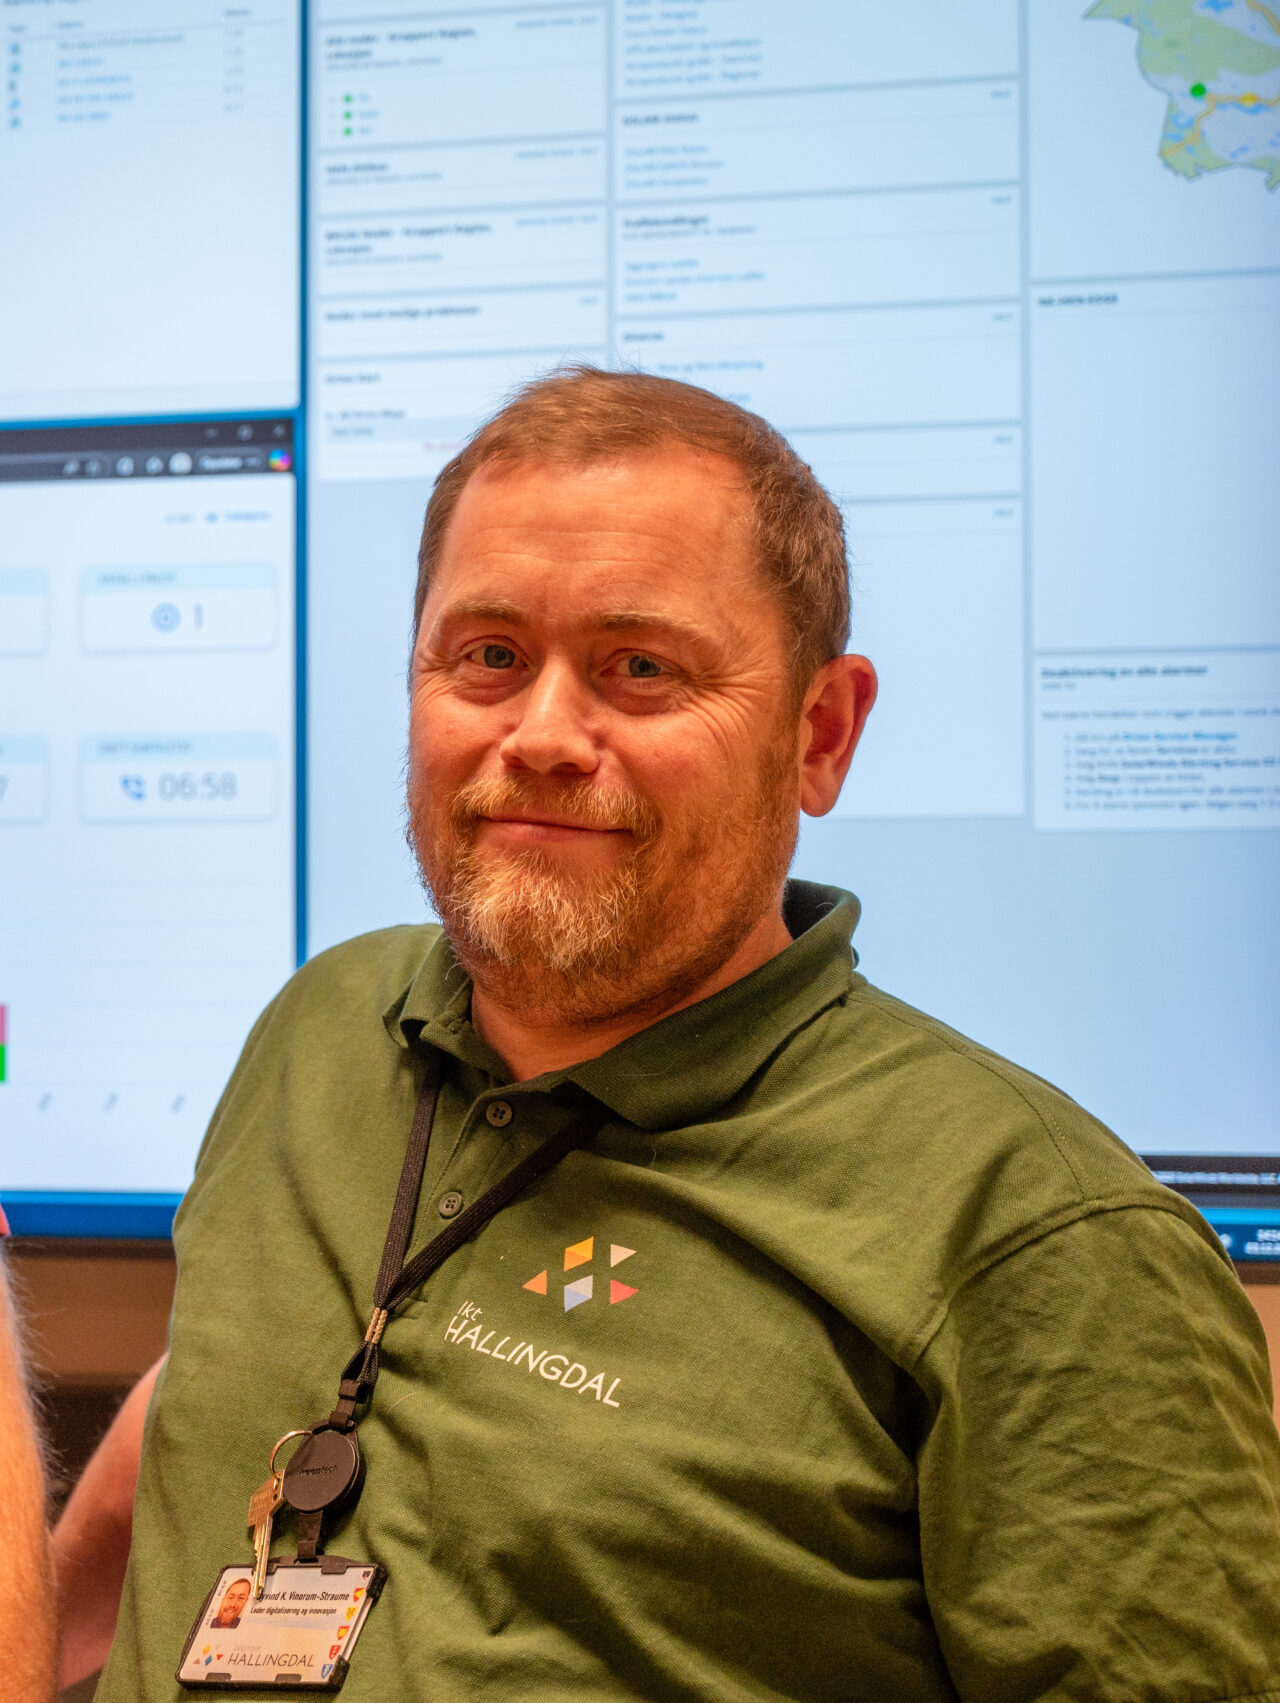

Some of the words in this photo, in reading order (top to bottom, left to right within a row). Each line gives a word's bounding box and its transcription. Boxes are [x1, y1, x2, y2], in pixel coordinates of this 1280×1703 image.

[158, 772, 238, 801] 06:58
[443, 1315, 622, 1408] HALLINGDAL
[228, 1653, 314, 1667] HALLINGDAL
